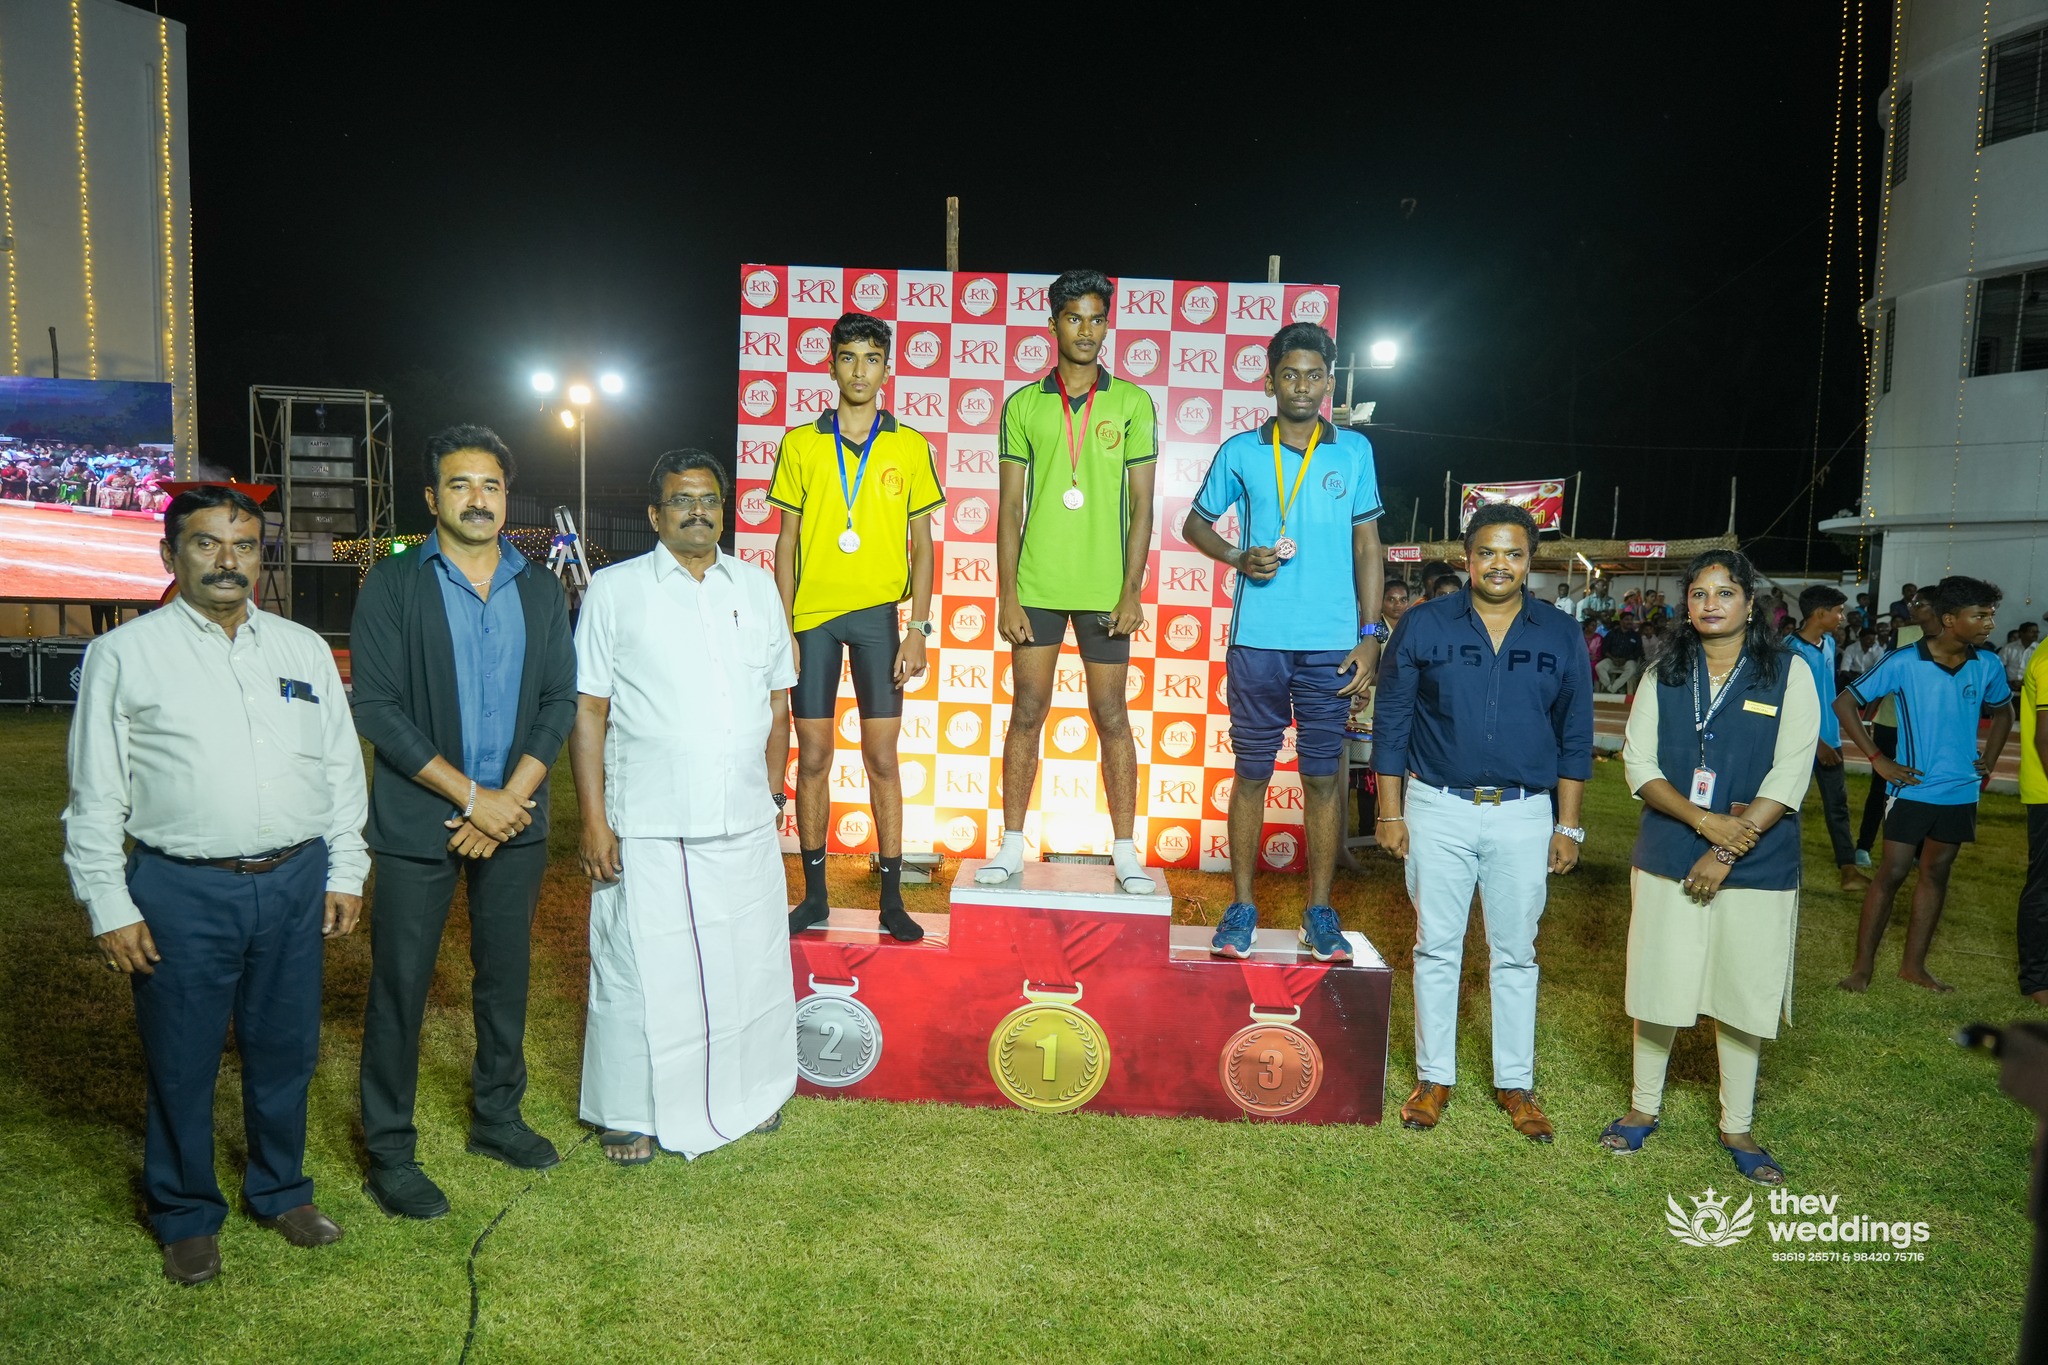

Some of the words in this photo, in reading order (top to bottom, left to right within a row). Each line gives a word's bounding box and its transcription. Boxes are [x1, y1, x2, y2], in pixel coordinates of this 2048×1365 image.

[749, 279, 771, 292] RR
[791, 278, 839, 304] RR
[858, 283, 881, 295] RR
[900, 281, 949, 308] RR
[968, 288, 990, 300] RR
[1120, 289, 1169, 315] RR
[1188, 296, 1211, 308] RR
[1230, 294, 1279, 321] RR
[1298, 300, 1321, 312] RR
[740, 330, 784, 356] RR
[803, 336, 825, 349] RR
[912, 340, 934, 352] RR
[1021, 344, 1043, 357] RR
[953, 339, 1002, 365] RR
[1130, 348, 1153, 361] RR
[1172, 347, 1221, 374] RR
[1240, 354, 1262, 366] RR
[748, 389, 770, 401] RR
[789, 387, 837, 413] RR
[897, 391, 945, 417] RR
[964, 397, 986, 410] RR
[949, 448, 997, 474] RR
[744, 497, 766, 509] RR
[1391, 550, 1420, 558] CASHIER
[946, 556, 993, 582] RR
[1161, 566, 1210, 592] RR
[956, 614, 978, 626] RR
[1172, 624, 1194, 636] RR
[942, 663, 989, 689] RR
[1156, 673, 1205, 699] RR
[1152, 779, 1200, 804] RR
[1264, 786, 1304, 809] RR
[843, 820, 864, 831] RR
[1162, 835, 1184, 847] RR
[1269, 841, 1291, 852] RR
[820, 1024, 844, 1061] 2
[1035, 1034, 1058, 1081] 1
[1258, 1049, 1282, 1090] 3
